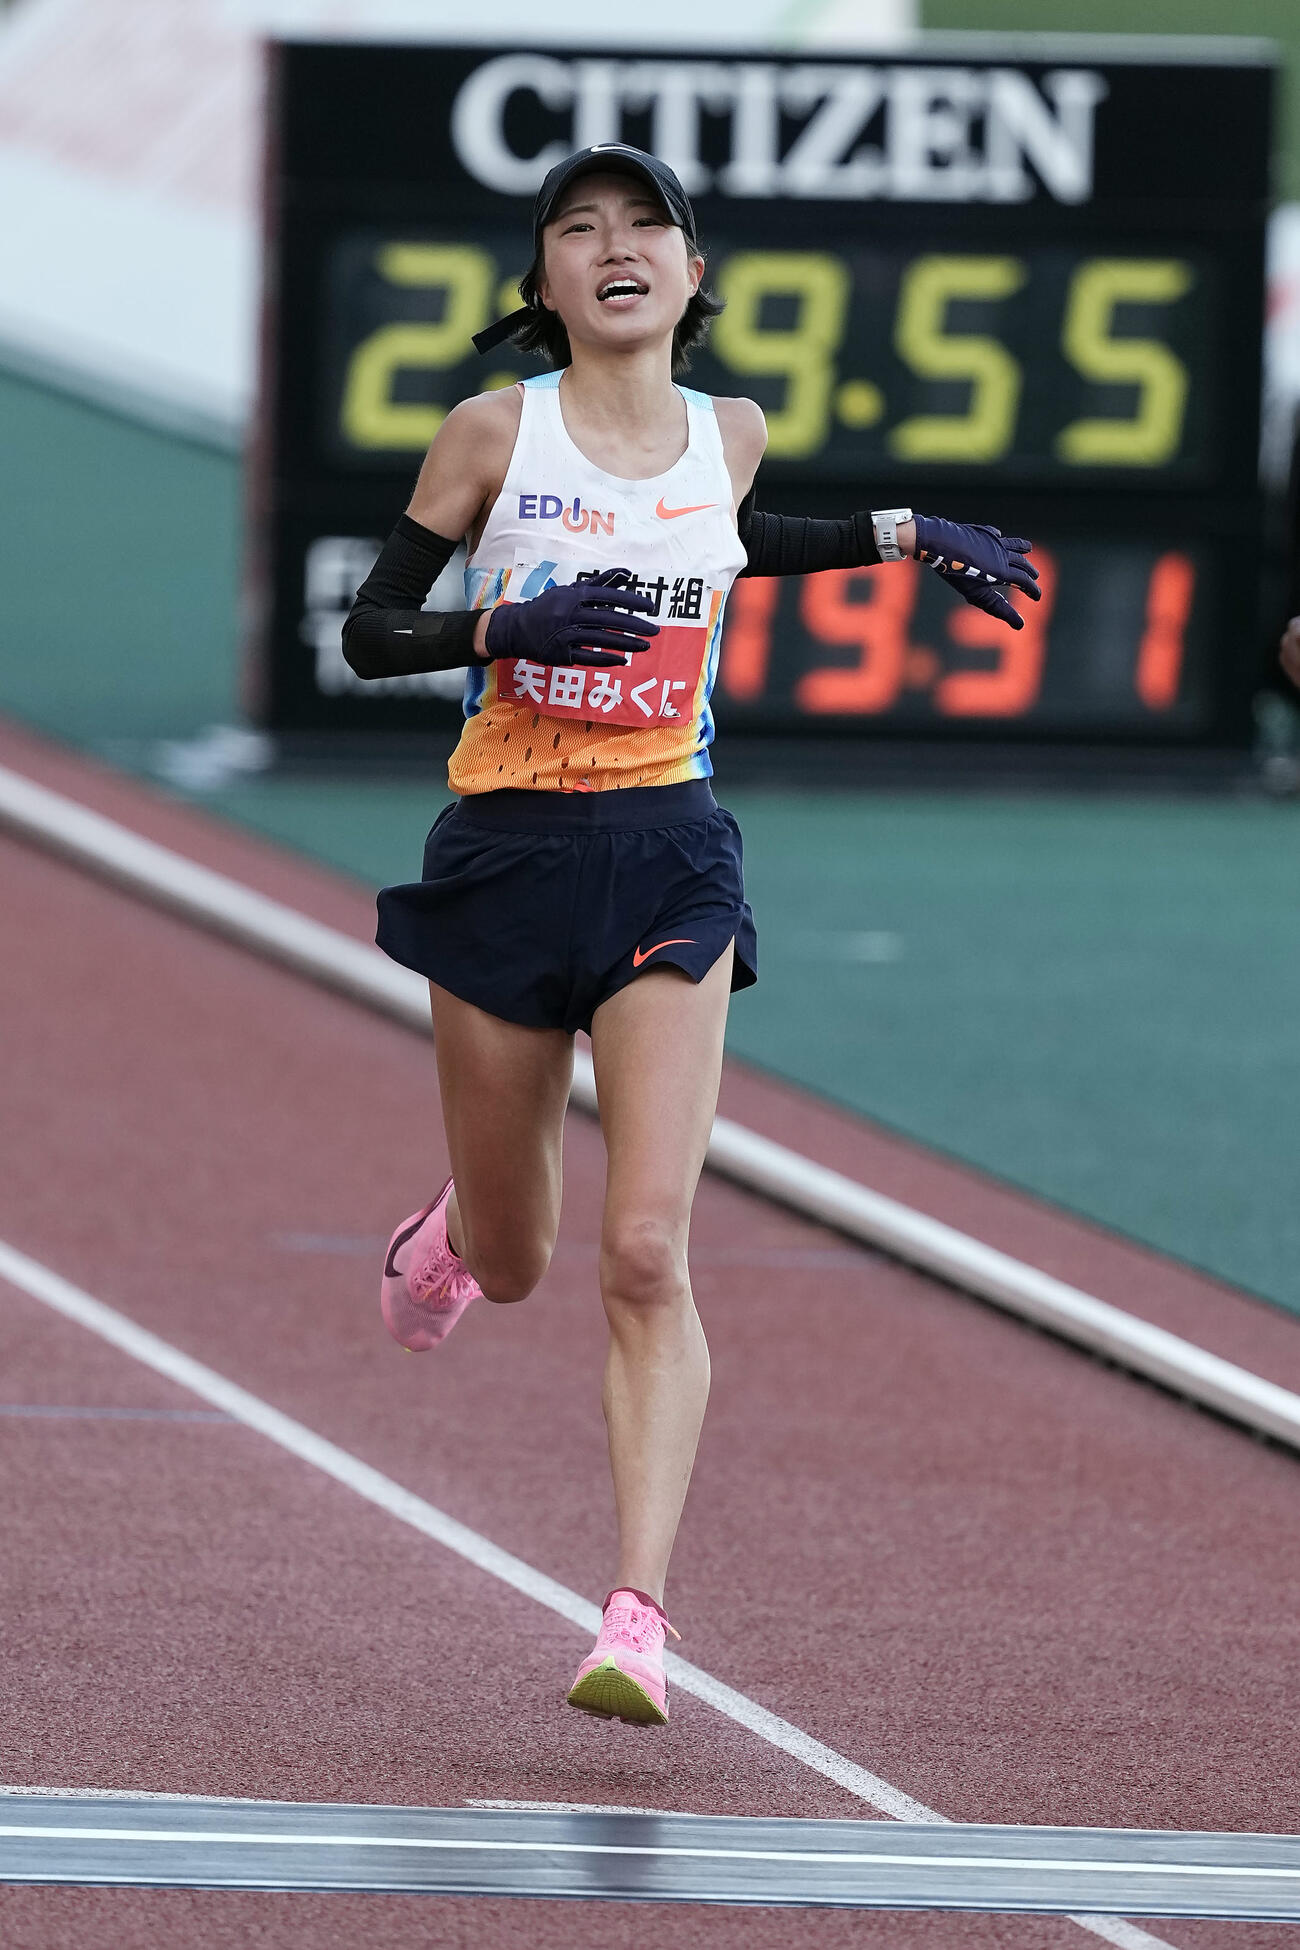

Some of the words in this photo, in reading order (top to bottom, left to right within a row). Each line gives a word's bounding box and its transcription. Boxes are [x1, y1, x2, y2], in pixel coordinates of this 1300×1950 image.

[453, 56, 1106, 204] CITIZEN
[518, 494, 615, 536] EDION
[577, 569, 703, 619] 村組
[513, 658, 686, 718] 矢田みくに
